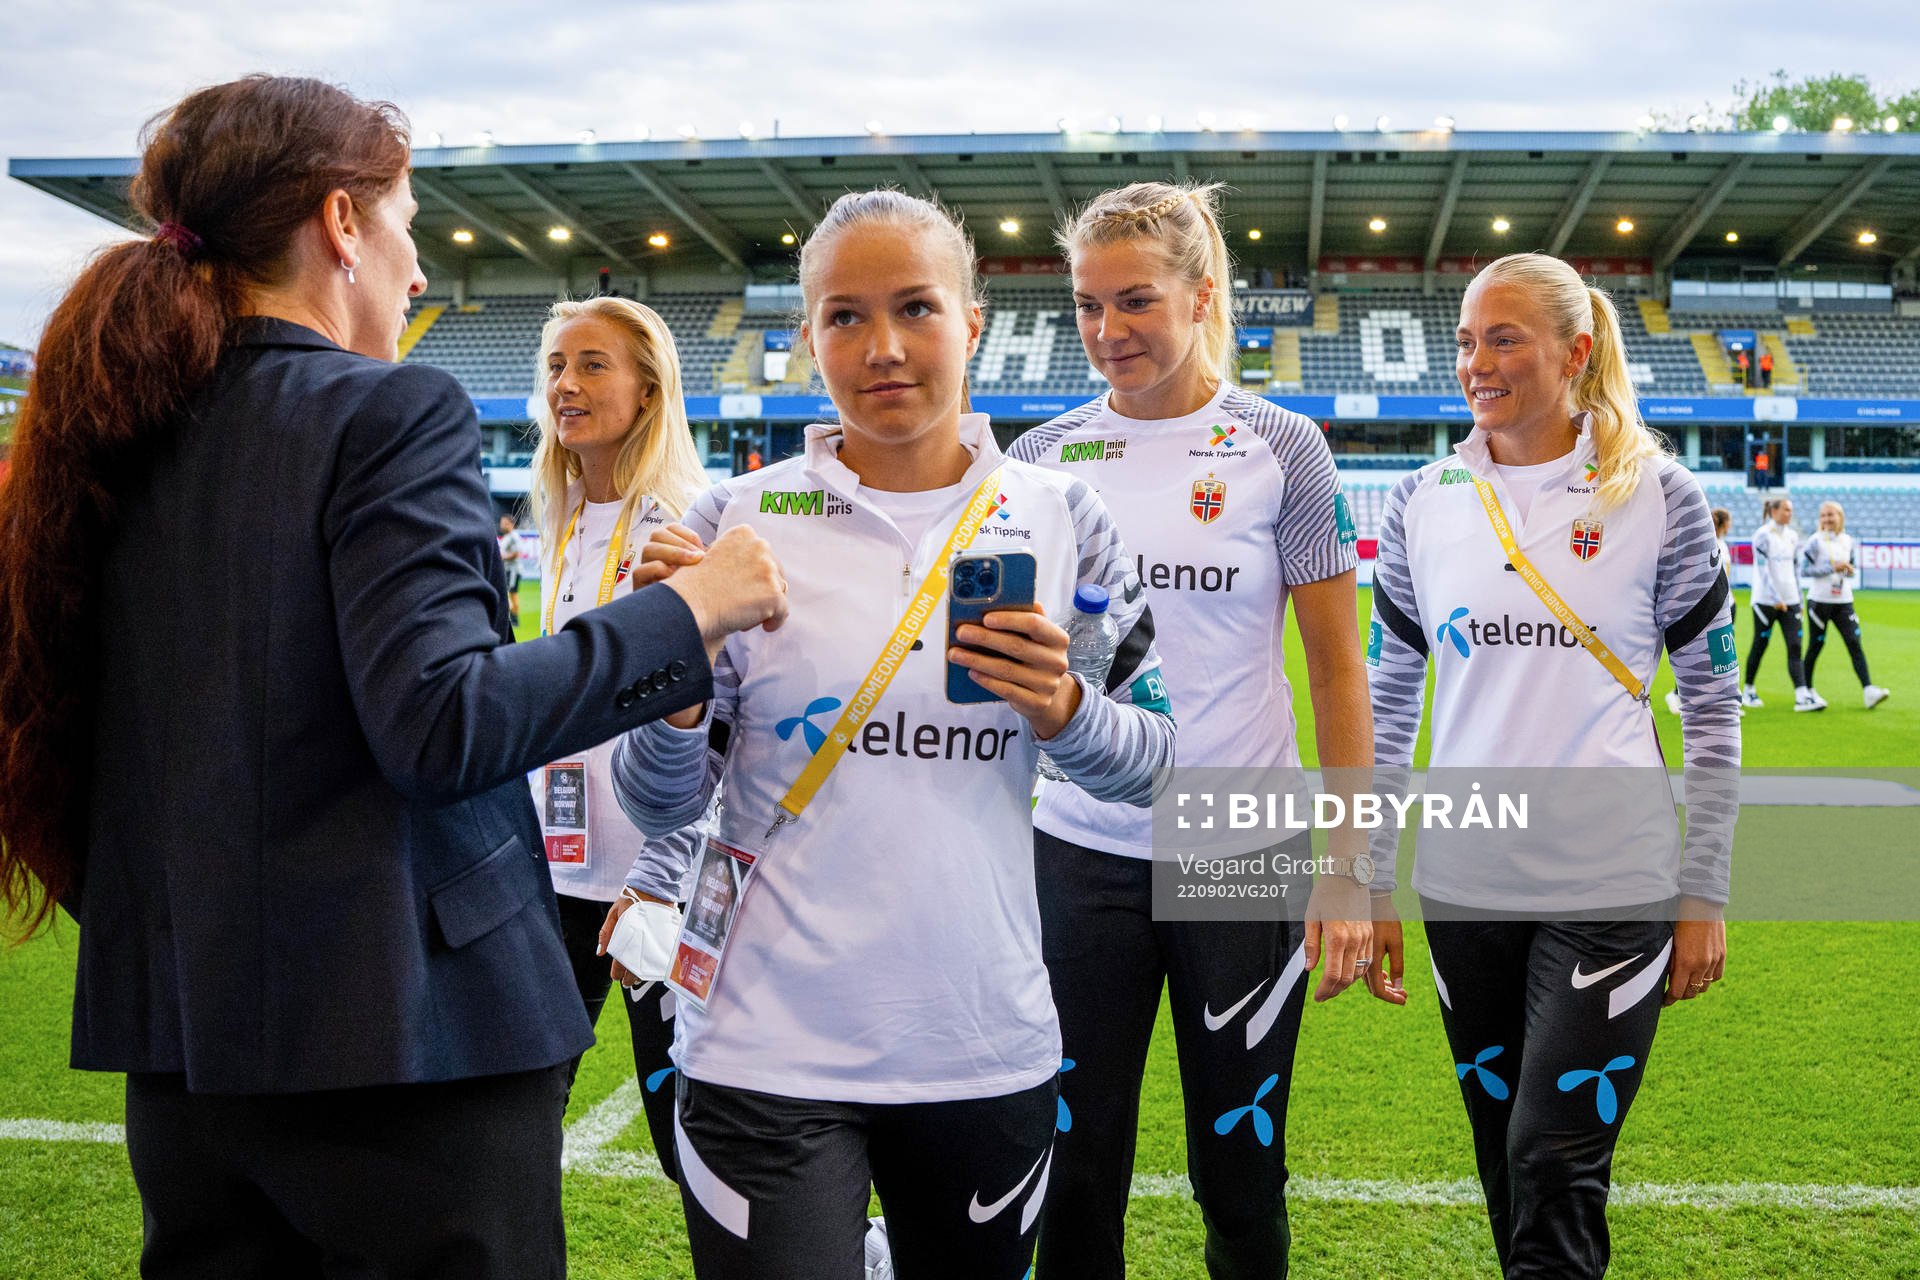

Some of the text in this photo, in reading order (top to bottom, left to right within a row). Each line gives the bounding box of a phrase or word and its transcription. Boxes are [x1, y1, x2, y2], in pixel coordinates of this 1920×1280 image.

[1060, 440, 1105, 462] KIWI
[1106, 439, 1126, 450] mini
[1105, 449, 1124, 461] pris
[1189, 449, 1247, 459] Norsk Tipping
[1567, 485, 1590, 494] Norsk
[760, 490, 824, 515] KIWI
[827, 501, 853, 518] pris
[992, 525, 1031, 540] Tipping
[1137, 554, 1240, 592] lenor
[847, 592, 935, 725] #COMEONBELGIUM
[847, 711, 1018, 762] elenor
